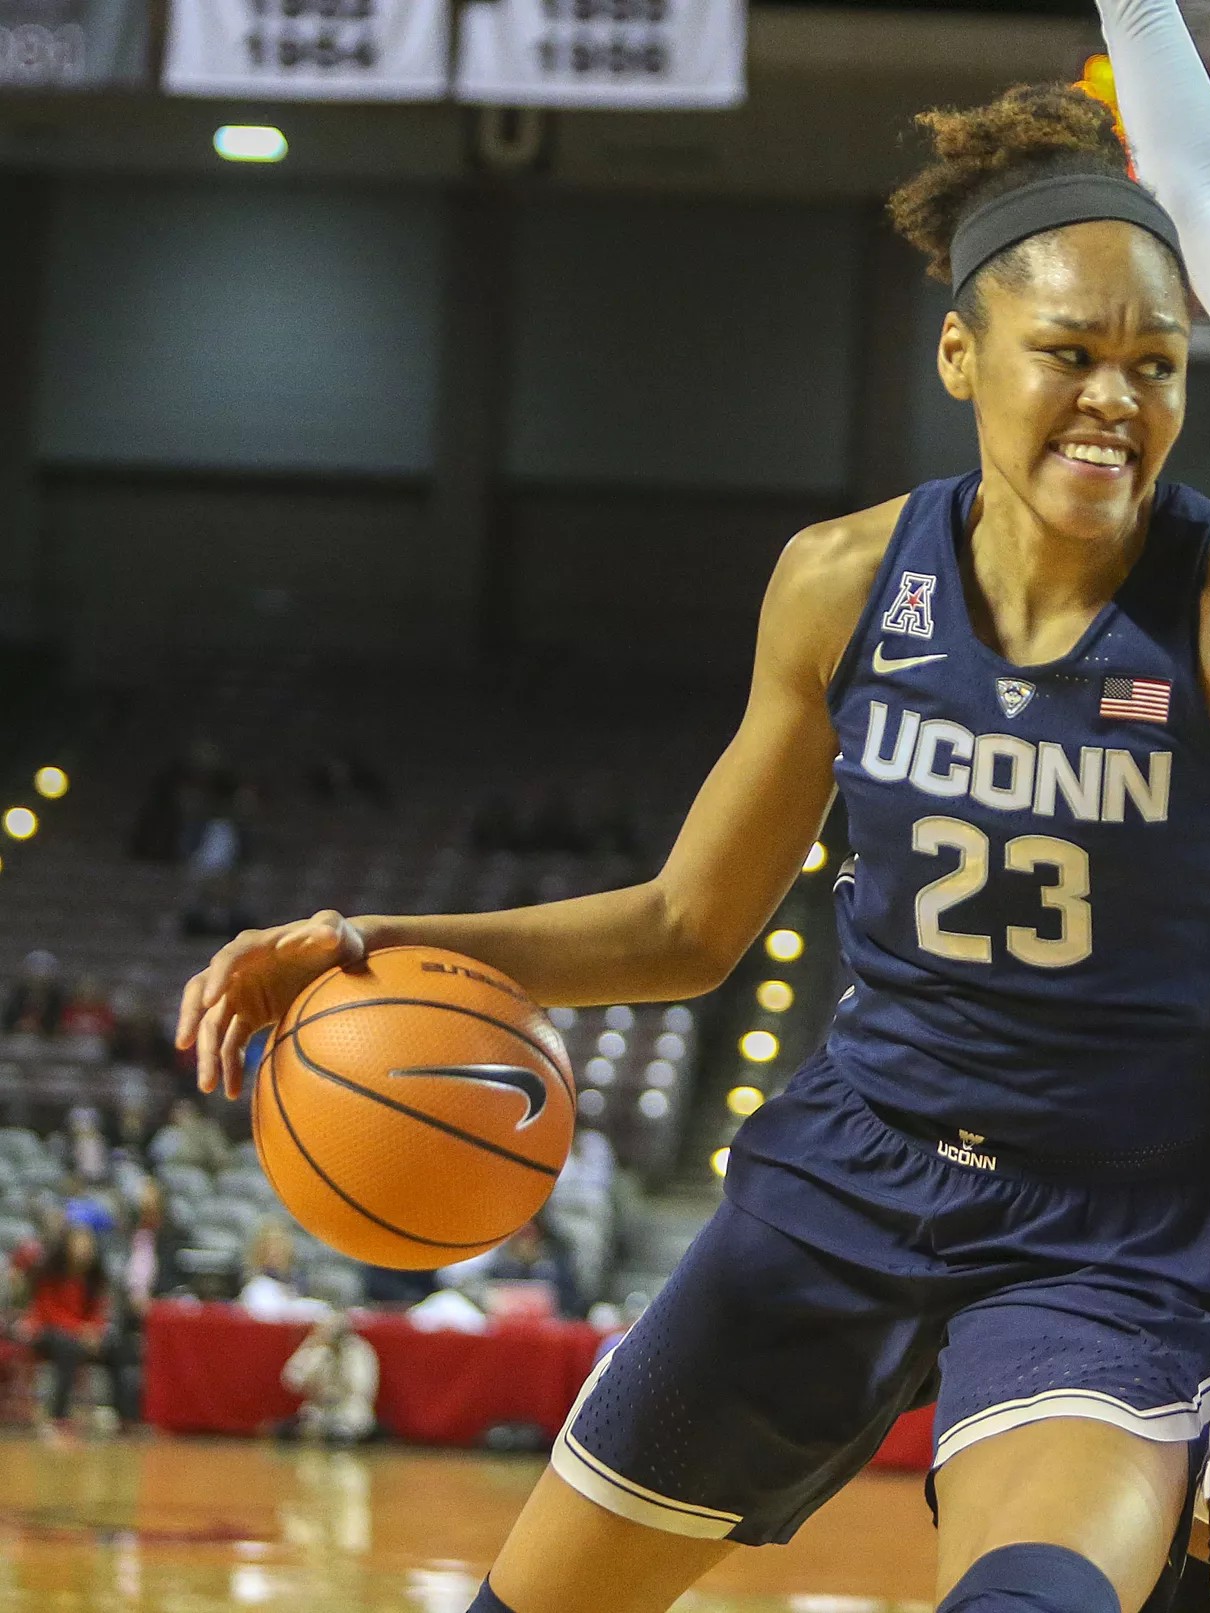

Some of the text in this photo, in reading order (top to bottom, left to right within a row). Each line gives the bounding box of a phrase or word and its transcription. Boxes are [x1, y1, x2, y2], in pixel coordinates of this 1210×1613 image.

[861, 700, 1173, 824] UCONN
[911, 815, 1093, 968] 23
[937, 1140, 997, 1171] UCONN
